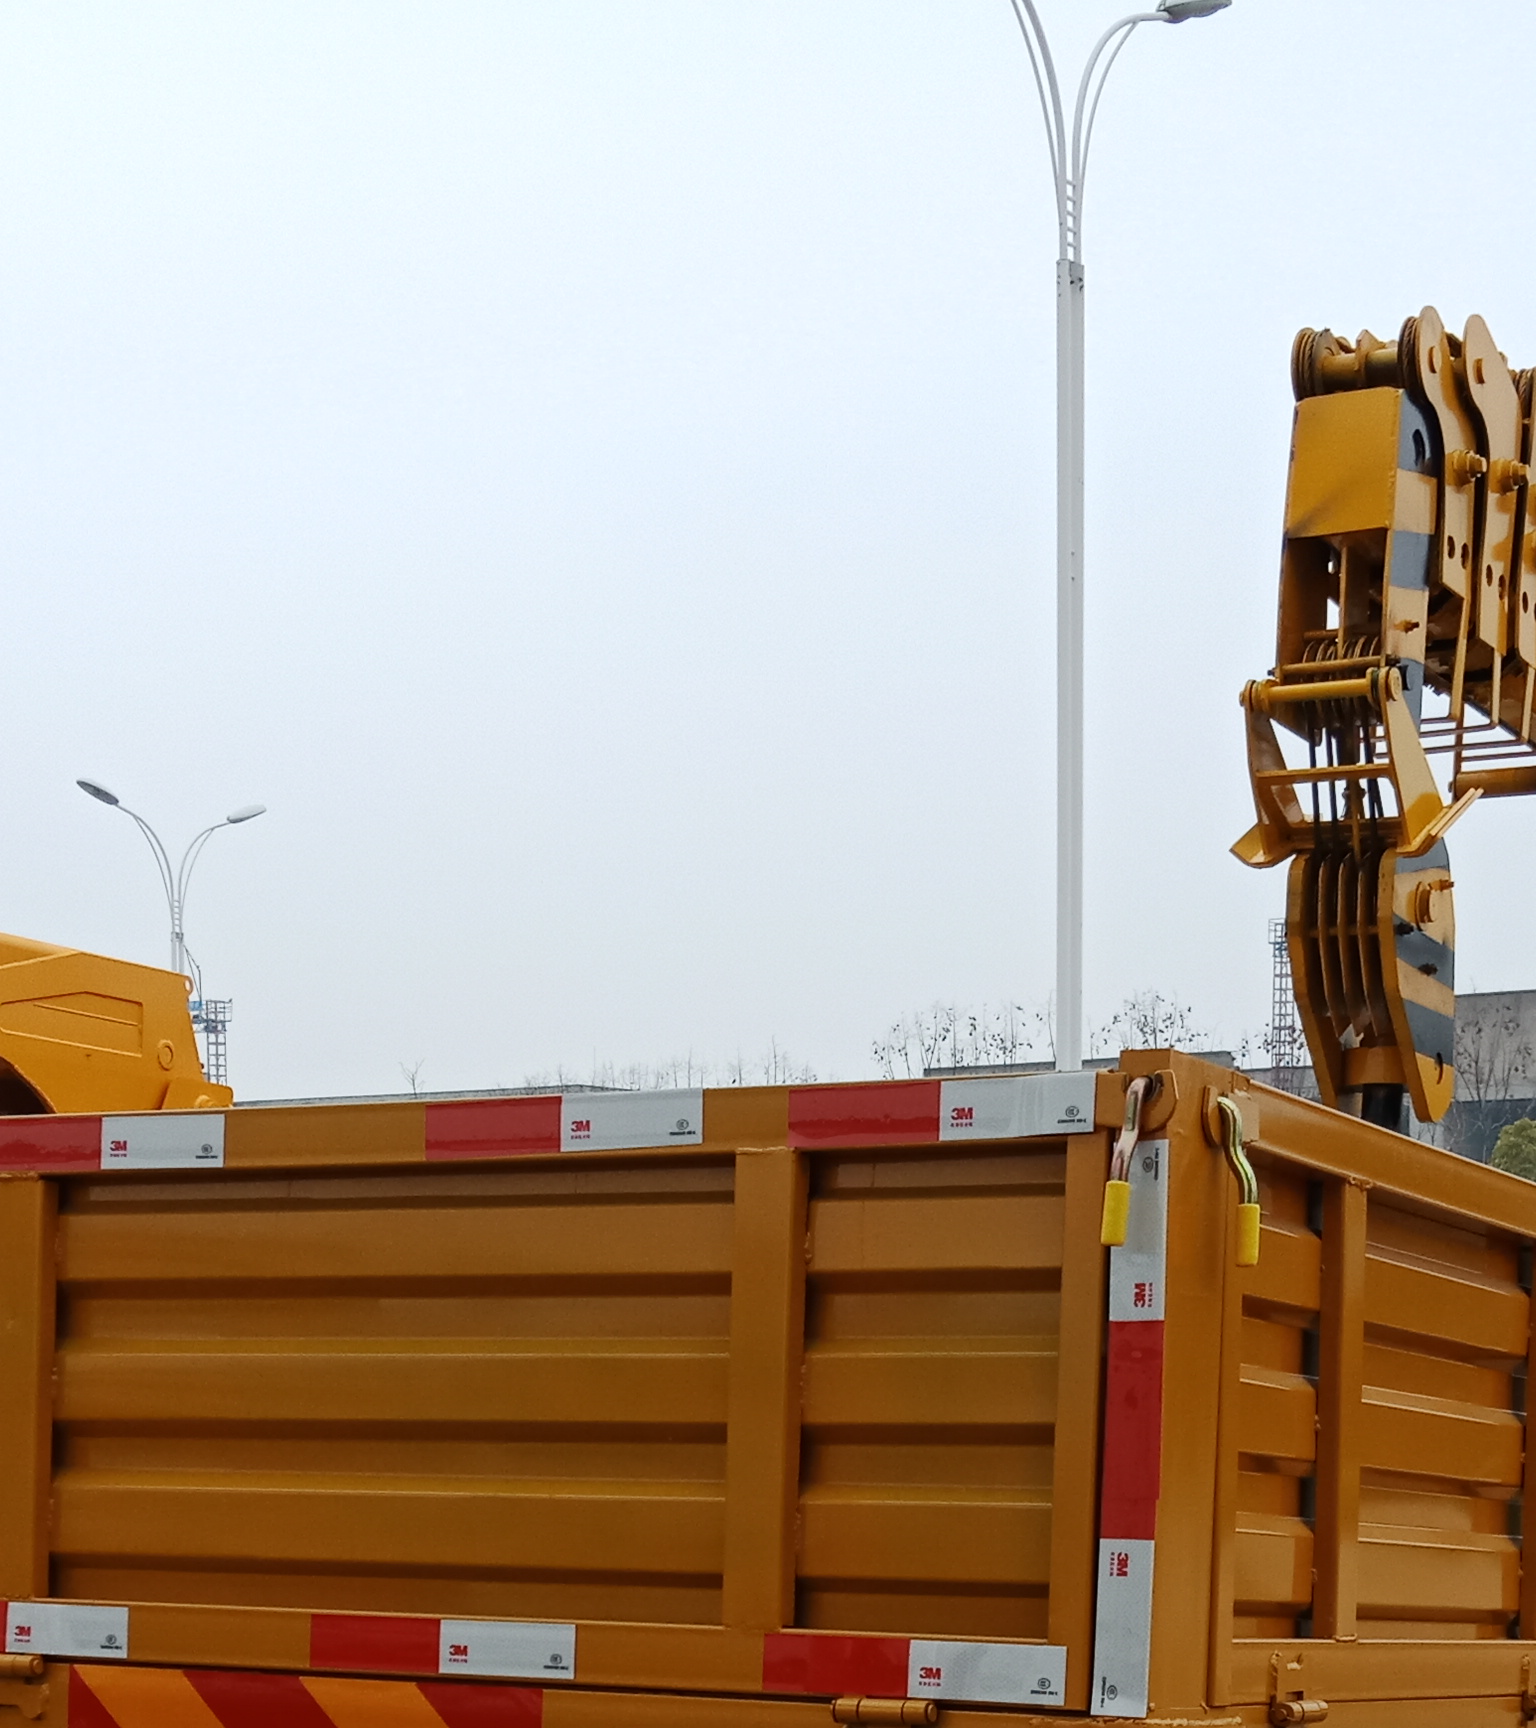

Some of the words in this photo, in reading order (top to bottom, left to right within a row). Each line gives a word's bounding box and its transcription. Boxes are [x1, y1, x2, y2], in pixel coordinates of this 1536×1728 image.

[951, 1107, 973, 1120] 3M
[570, 1120, 590, 1132] 3M
[110, 1140, 127, 1152] 3M
[1133, 1282, 1146, 1308] 3M
[1116, 1552, 1129, 1577] 3M
[14, 1626, 31, 1637] 3M
[448, 1644, 468, 1656] 3M
[919, 1667, 942, 1680] 3M
